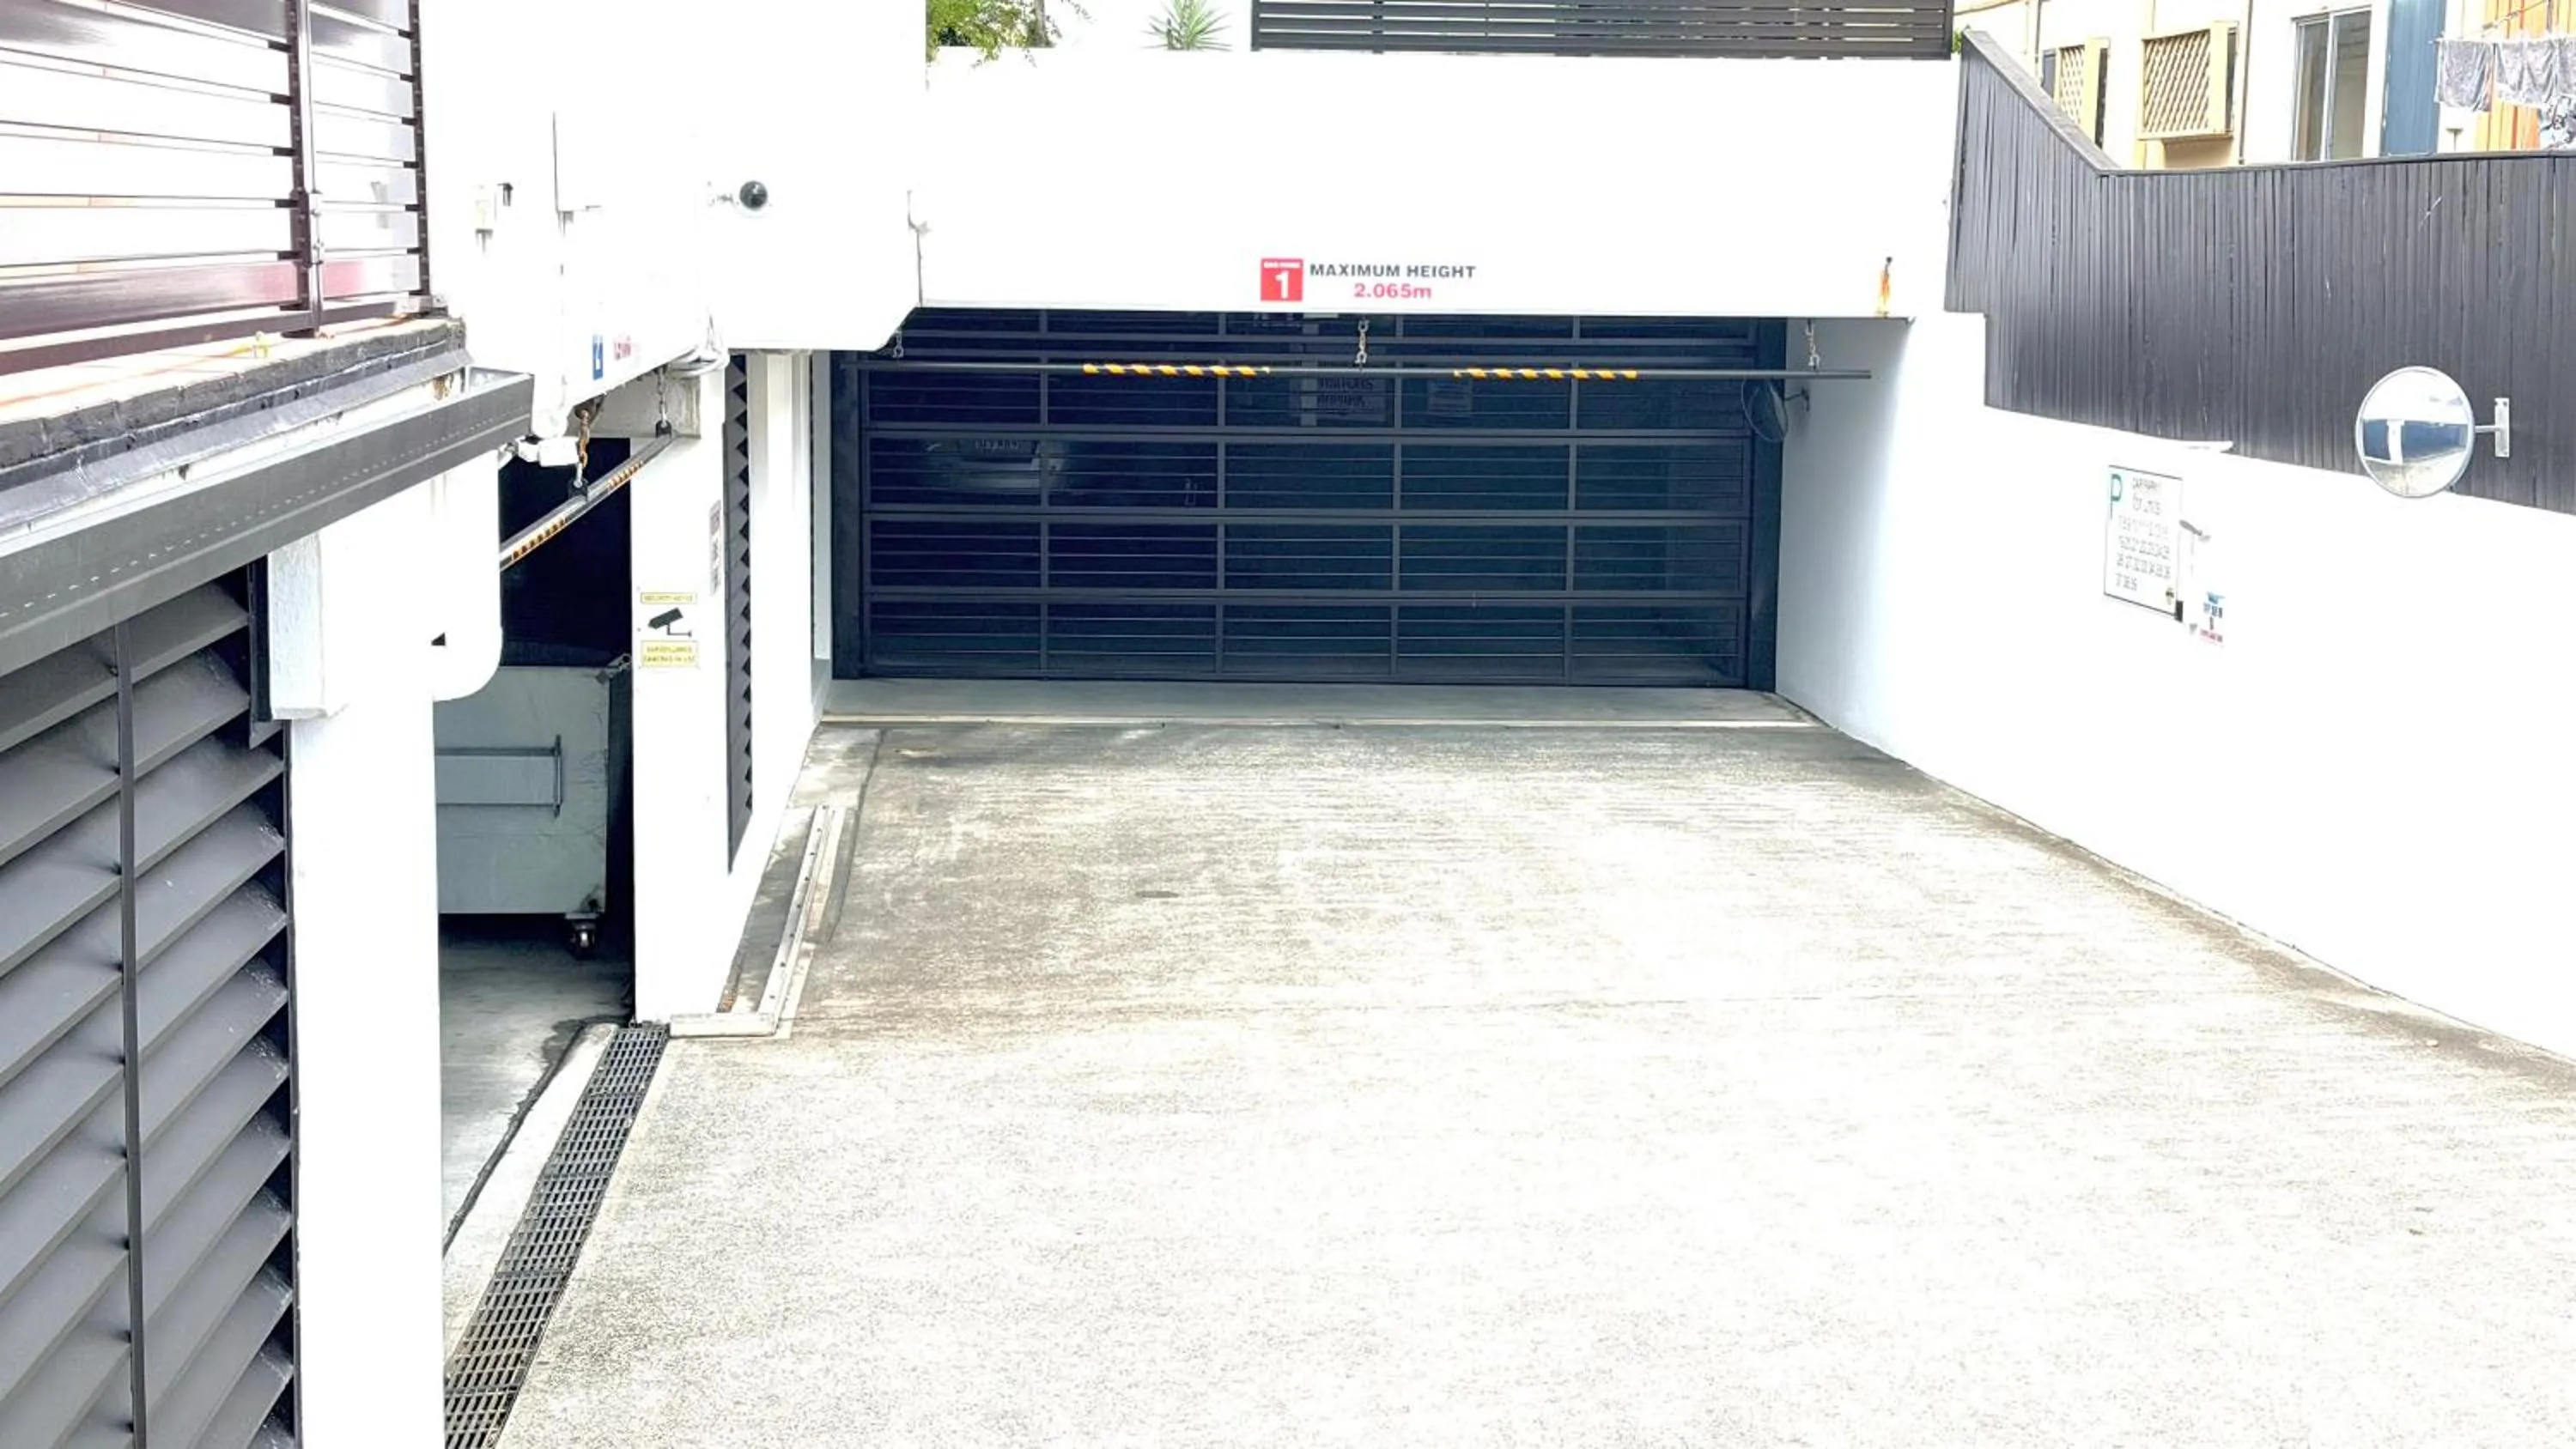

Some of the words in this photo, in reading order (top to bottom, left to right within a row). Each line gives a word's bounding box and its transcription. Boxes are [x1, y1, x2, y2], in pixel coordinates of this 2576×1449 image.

[1309, 264, 1400, 276] MAXIMUM
[1406, 265, 1476, 278] HEIGHT
[1275, 270, 1289, 300] 1
[1354, 282, 1432, 299] 2.065m
[2110, 473, 2123, 518] P
